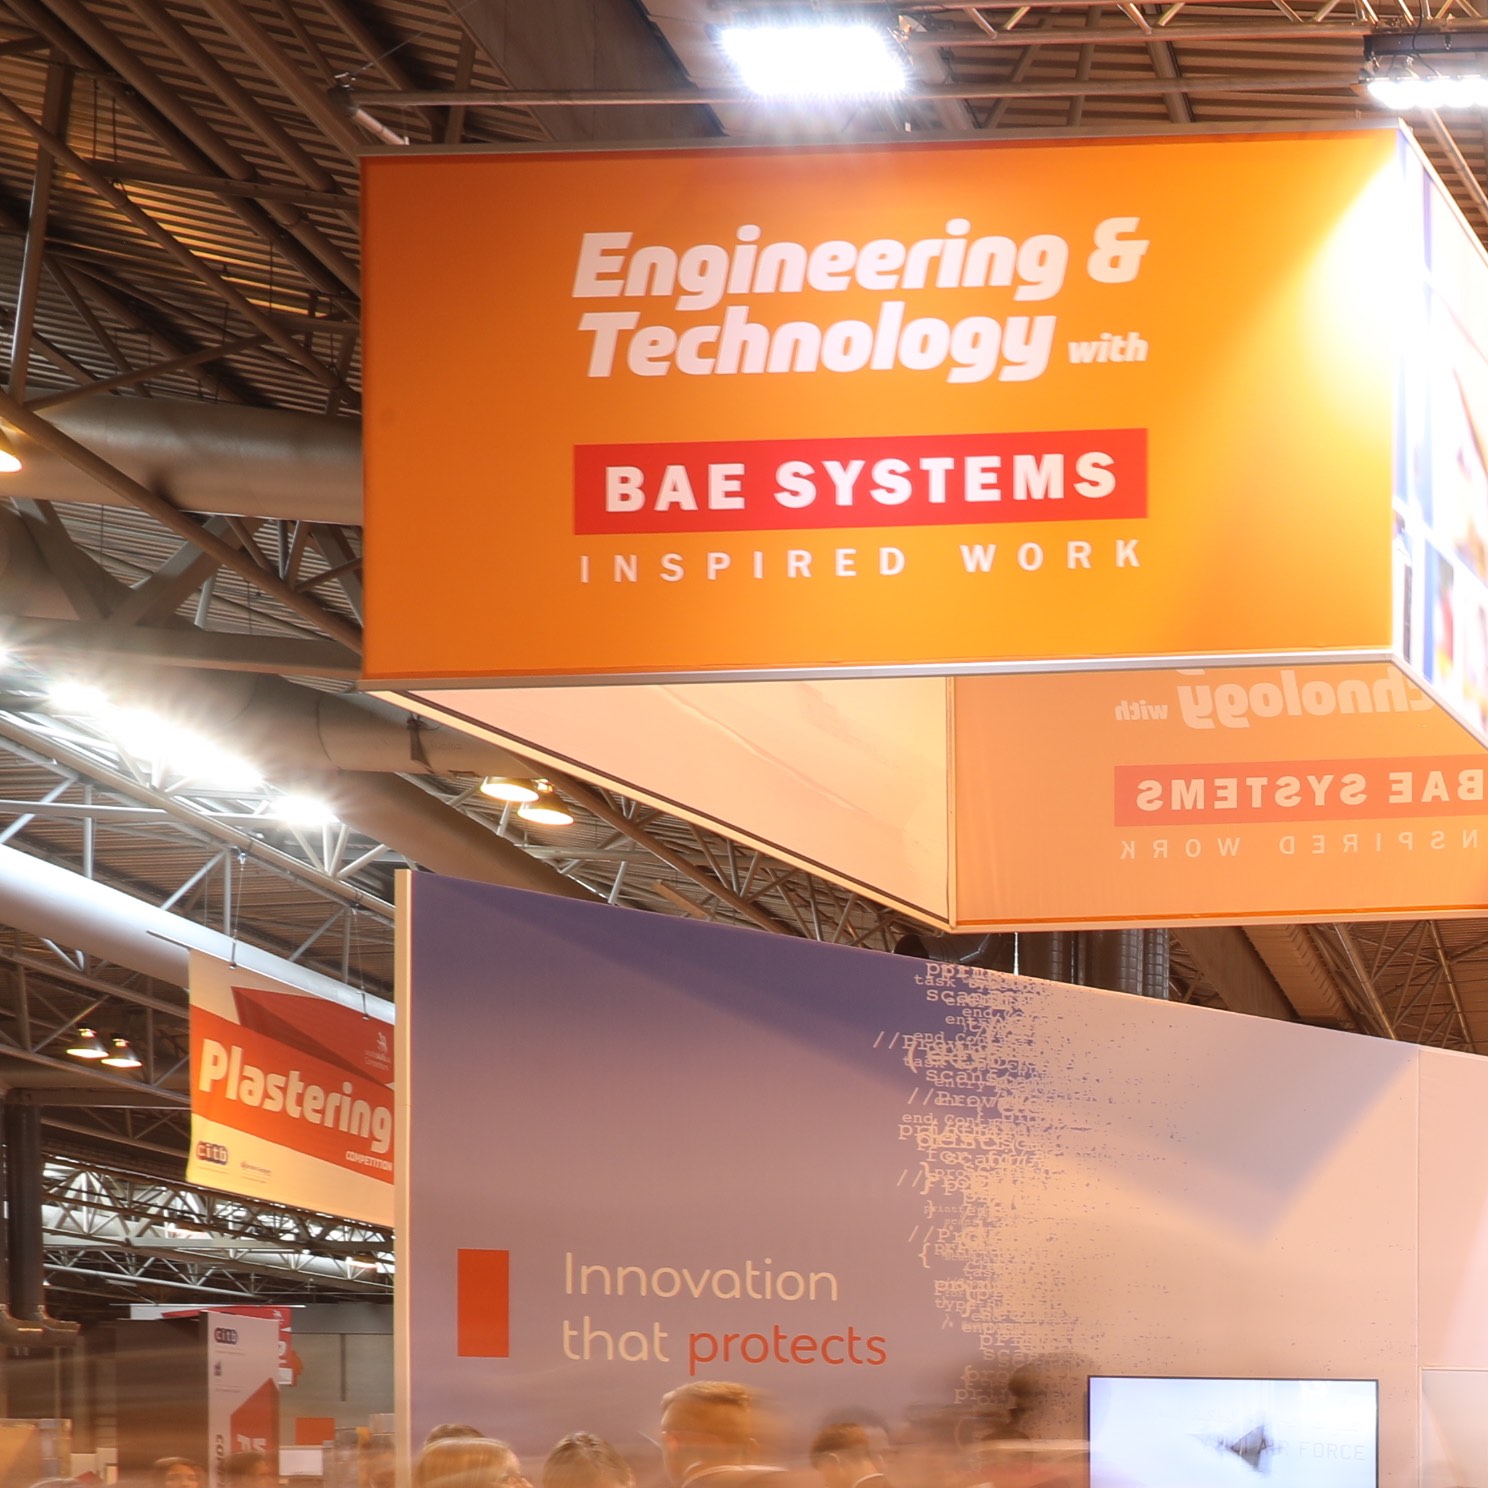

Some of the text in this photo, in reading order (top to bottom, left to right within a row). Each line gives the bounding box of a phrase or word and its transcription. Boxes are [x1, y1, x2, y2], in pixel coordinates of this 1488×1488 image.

[572, 216, 1150, 311] Engineering &
[578, 301, 1149, 383] Technology with
[604, 451, 1117, 513] BAE SYSTEMS
[581, 538, 1141, 583] INSPIRED WORK
[199, 1038, 392, 1154] Plastering
[346, 1150, 392, 1171] COMPETITION
[564, 1251, 839, 1302] Innovation
[562, 1316, 887, 1376] that protects
[1299, 1441, 1366, 1462] FORCE
